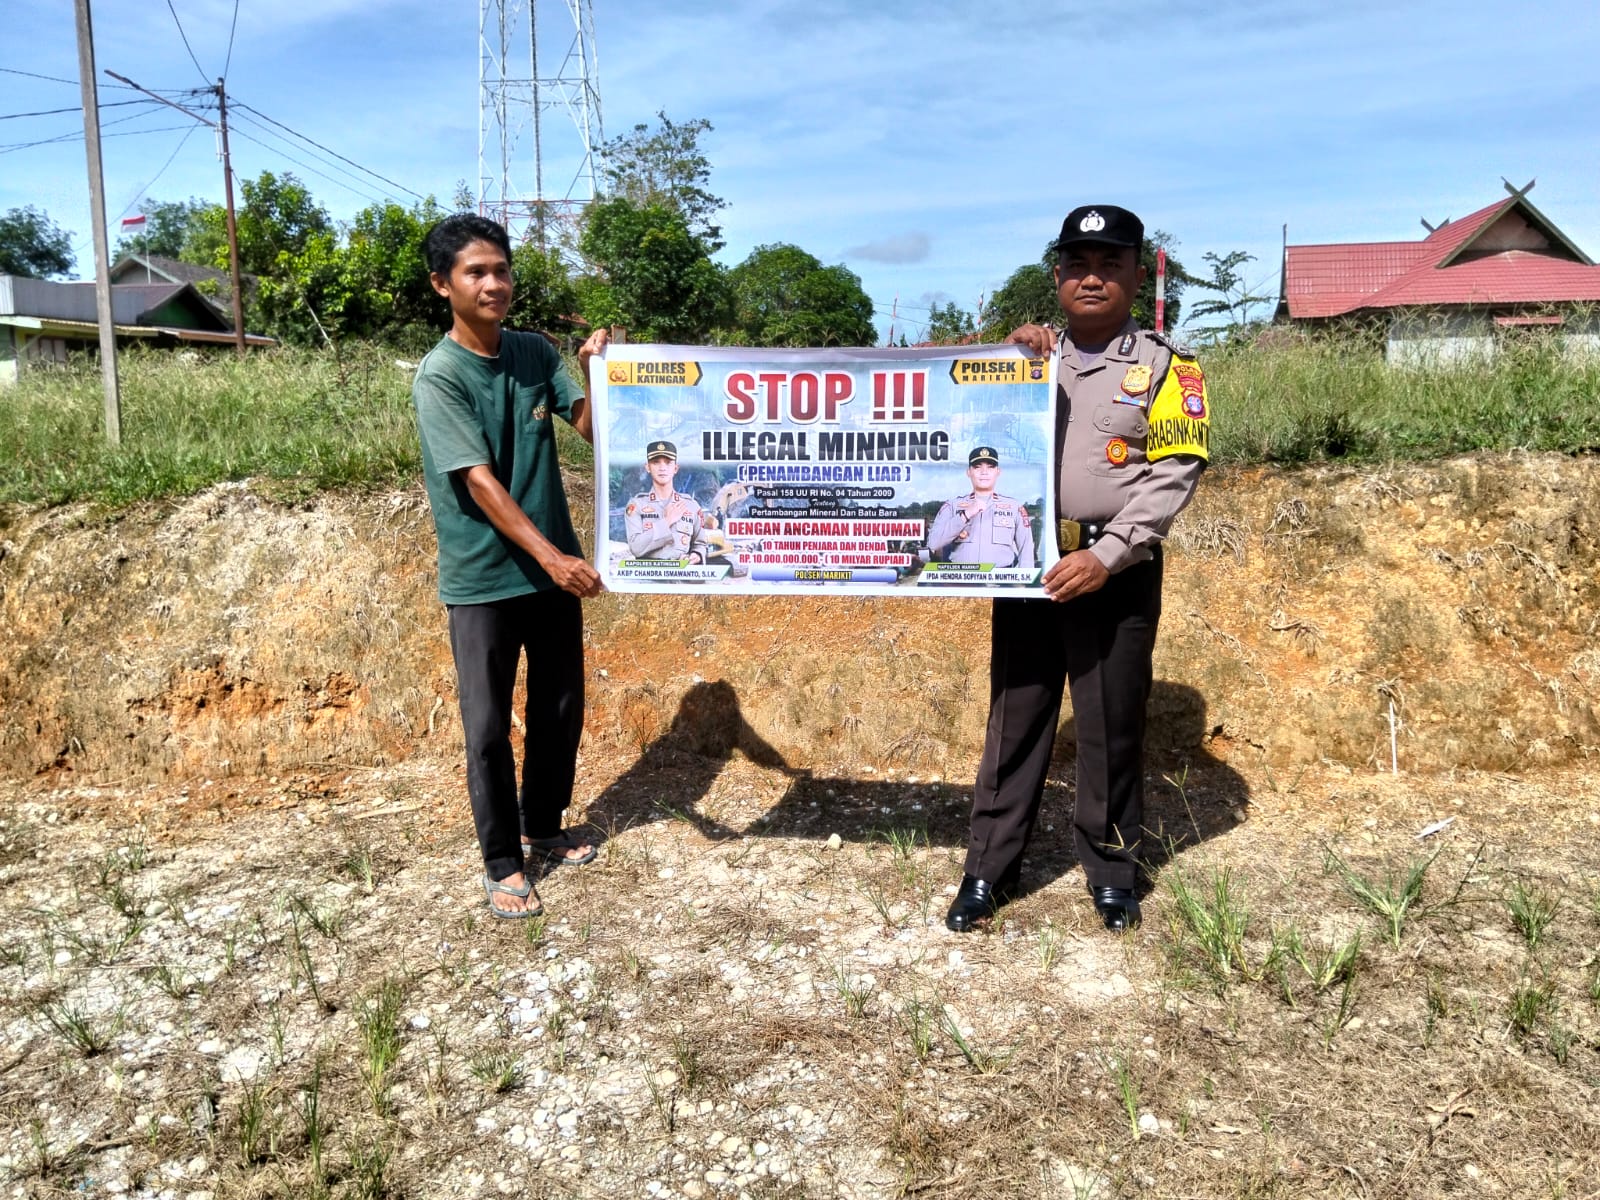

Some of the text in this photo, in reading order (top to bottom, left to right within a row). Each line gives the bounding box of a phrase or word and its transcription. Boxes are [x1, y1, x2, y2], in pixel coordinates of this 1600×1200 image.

[637, 362, 686, 374] POLRES
[961, 361, 1016, 373] POLSEK
[637, 375, 686, 384] KATINGAN
[962, 374, 1016, 382] MARIKIT
[726, 371, 925, 421] STOP !!!
[702, 430, 949, 462] ILLEGAL MINNING
[757, 488, 893, 497] Pasal 158 UU RI No. 04 Tahun 2009
[751, 508, 898, 518] Pertambangan Mineral Dan Batu Bara
[728, 522, 921, 537] DENGAN ANCAMAN HUKUMAN
[762, 541, 886, 552] 10 TAHUN PENJARA DAN DENDA
[841, 554, 871, 564] MILYAR
[617, 569, 634, 577] AKBP
[663, 570, 701, 578] ISMAWANTO,
[794, 570, 853, 580] POLSEK MARIKIT
[940, 572, 962, 580] HENDRA
[988, 573, 994, 581] D.
[995, 573, 1020, 581] MUNTHE,
